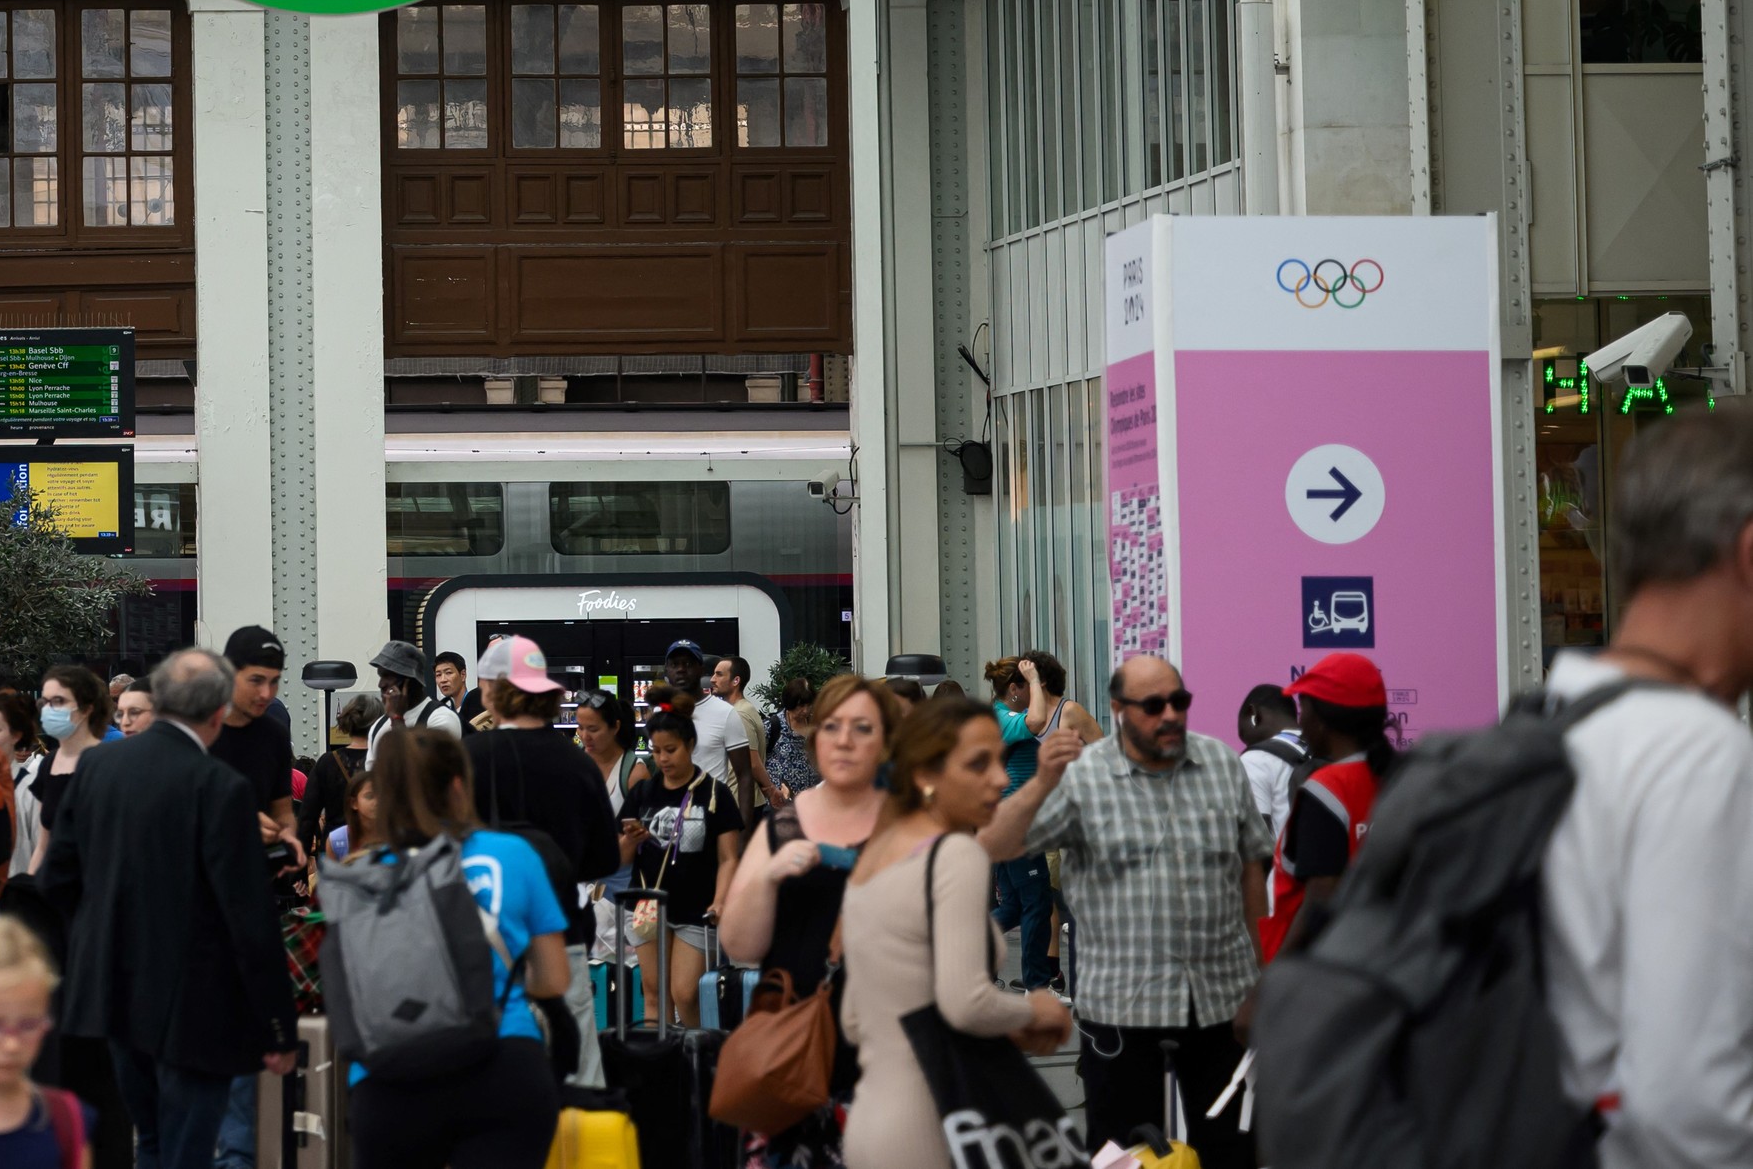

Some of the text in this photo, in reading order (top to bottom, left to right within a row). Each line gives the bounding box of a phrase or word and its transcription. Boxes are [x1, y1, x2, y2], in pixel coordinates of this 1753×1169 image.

[1123, 257, 1144, 291] PARIS
[1124, 294, 1144, 325] 2024
[577, 589, 637, 616] Foodies
[943, 1108, 1091, 1169] fnac
